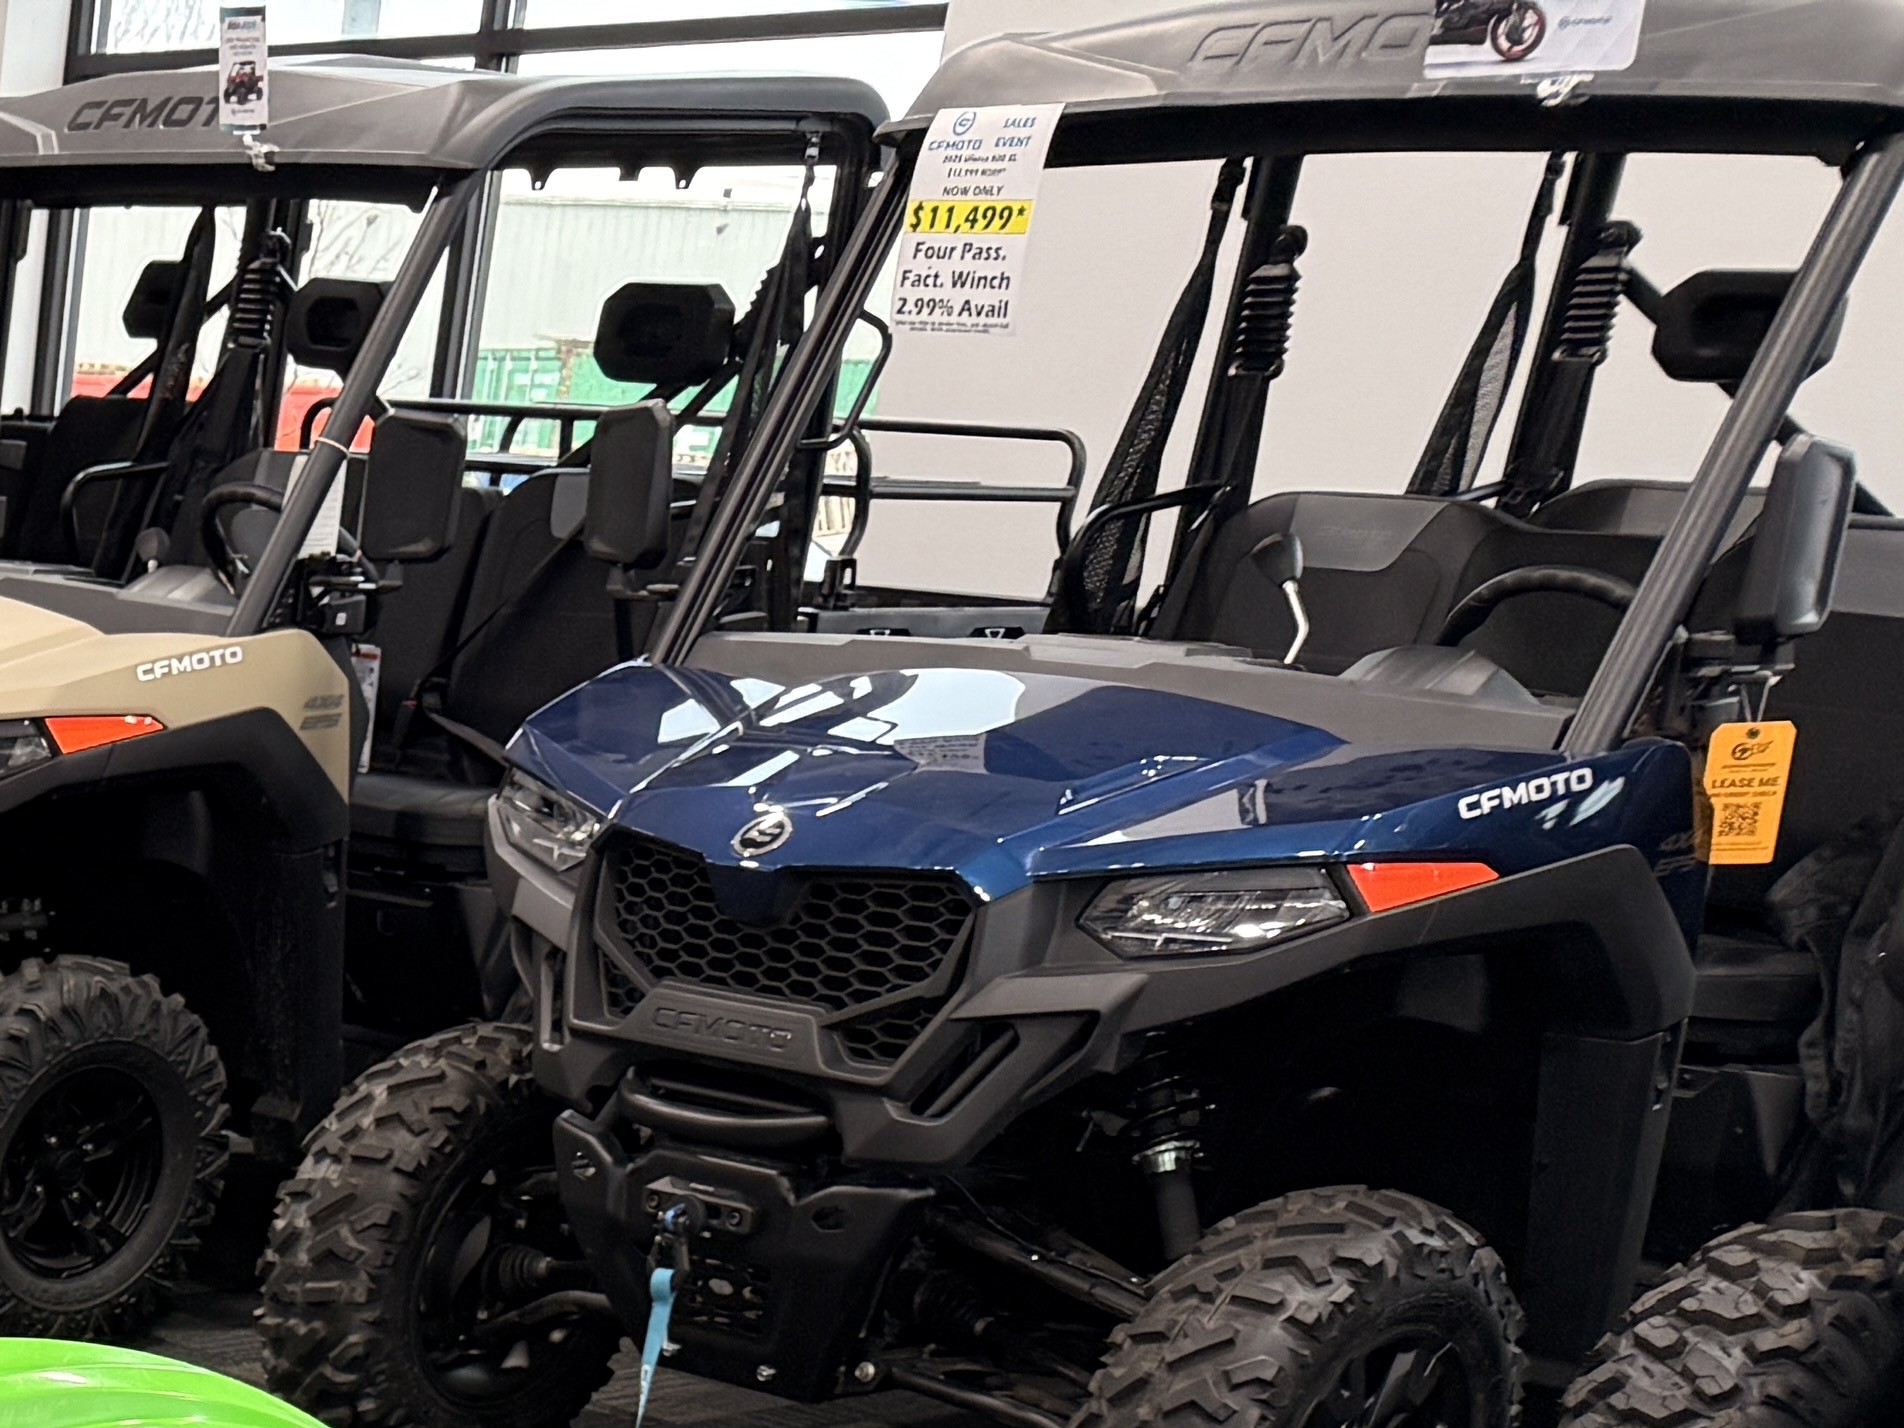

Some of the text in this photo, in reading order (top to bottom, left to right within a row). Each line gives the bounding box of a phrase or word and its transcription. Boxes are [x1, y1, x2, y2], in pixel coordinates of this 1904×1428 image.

[1190, 12, 1432, 64] CFMO
[65, 95, 220, 133] CFMOT
[1003, 117, 1037, 129] SALES
[994, 135, 1032, 148] EVENT
[942, 184, 1004, 197] NOW ONLY
[913, 241, 958, 261] Four
[900, 269, 1011, 291] Fact. Winch
[895, 297, 1010, 320] 2.99% Avail
[136, 646, 243, 682] CFMOTO
[1458, 767, 1594, 820] CFMOTO
[1711, 776, 1781, 789] LEASE ME
